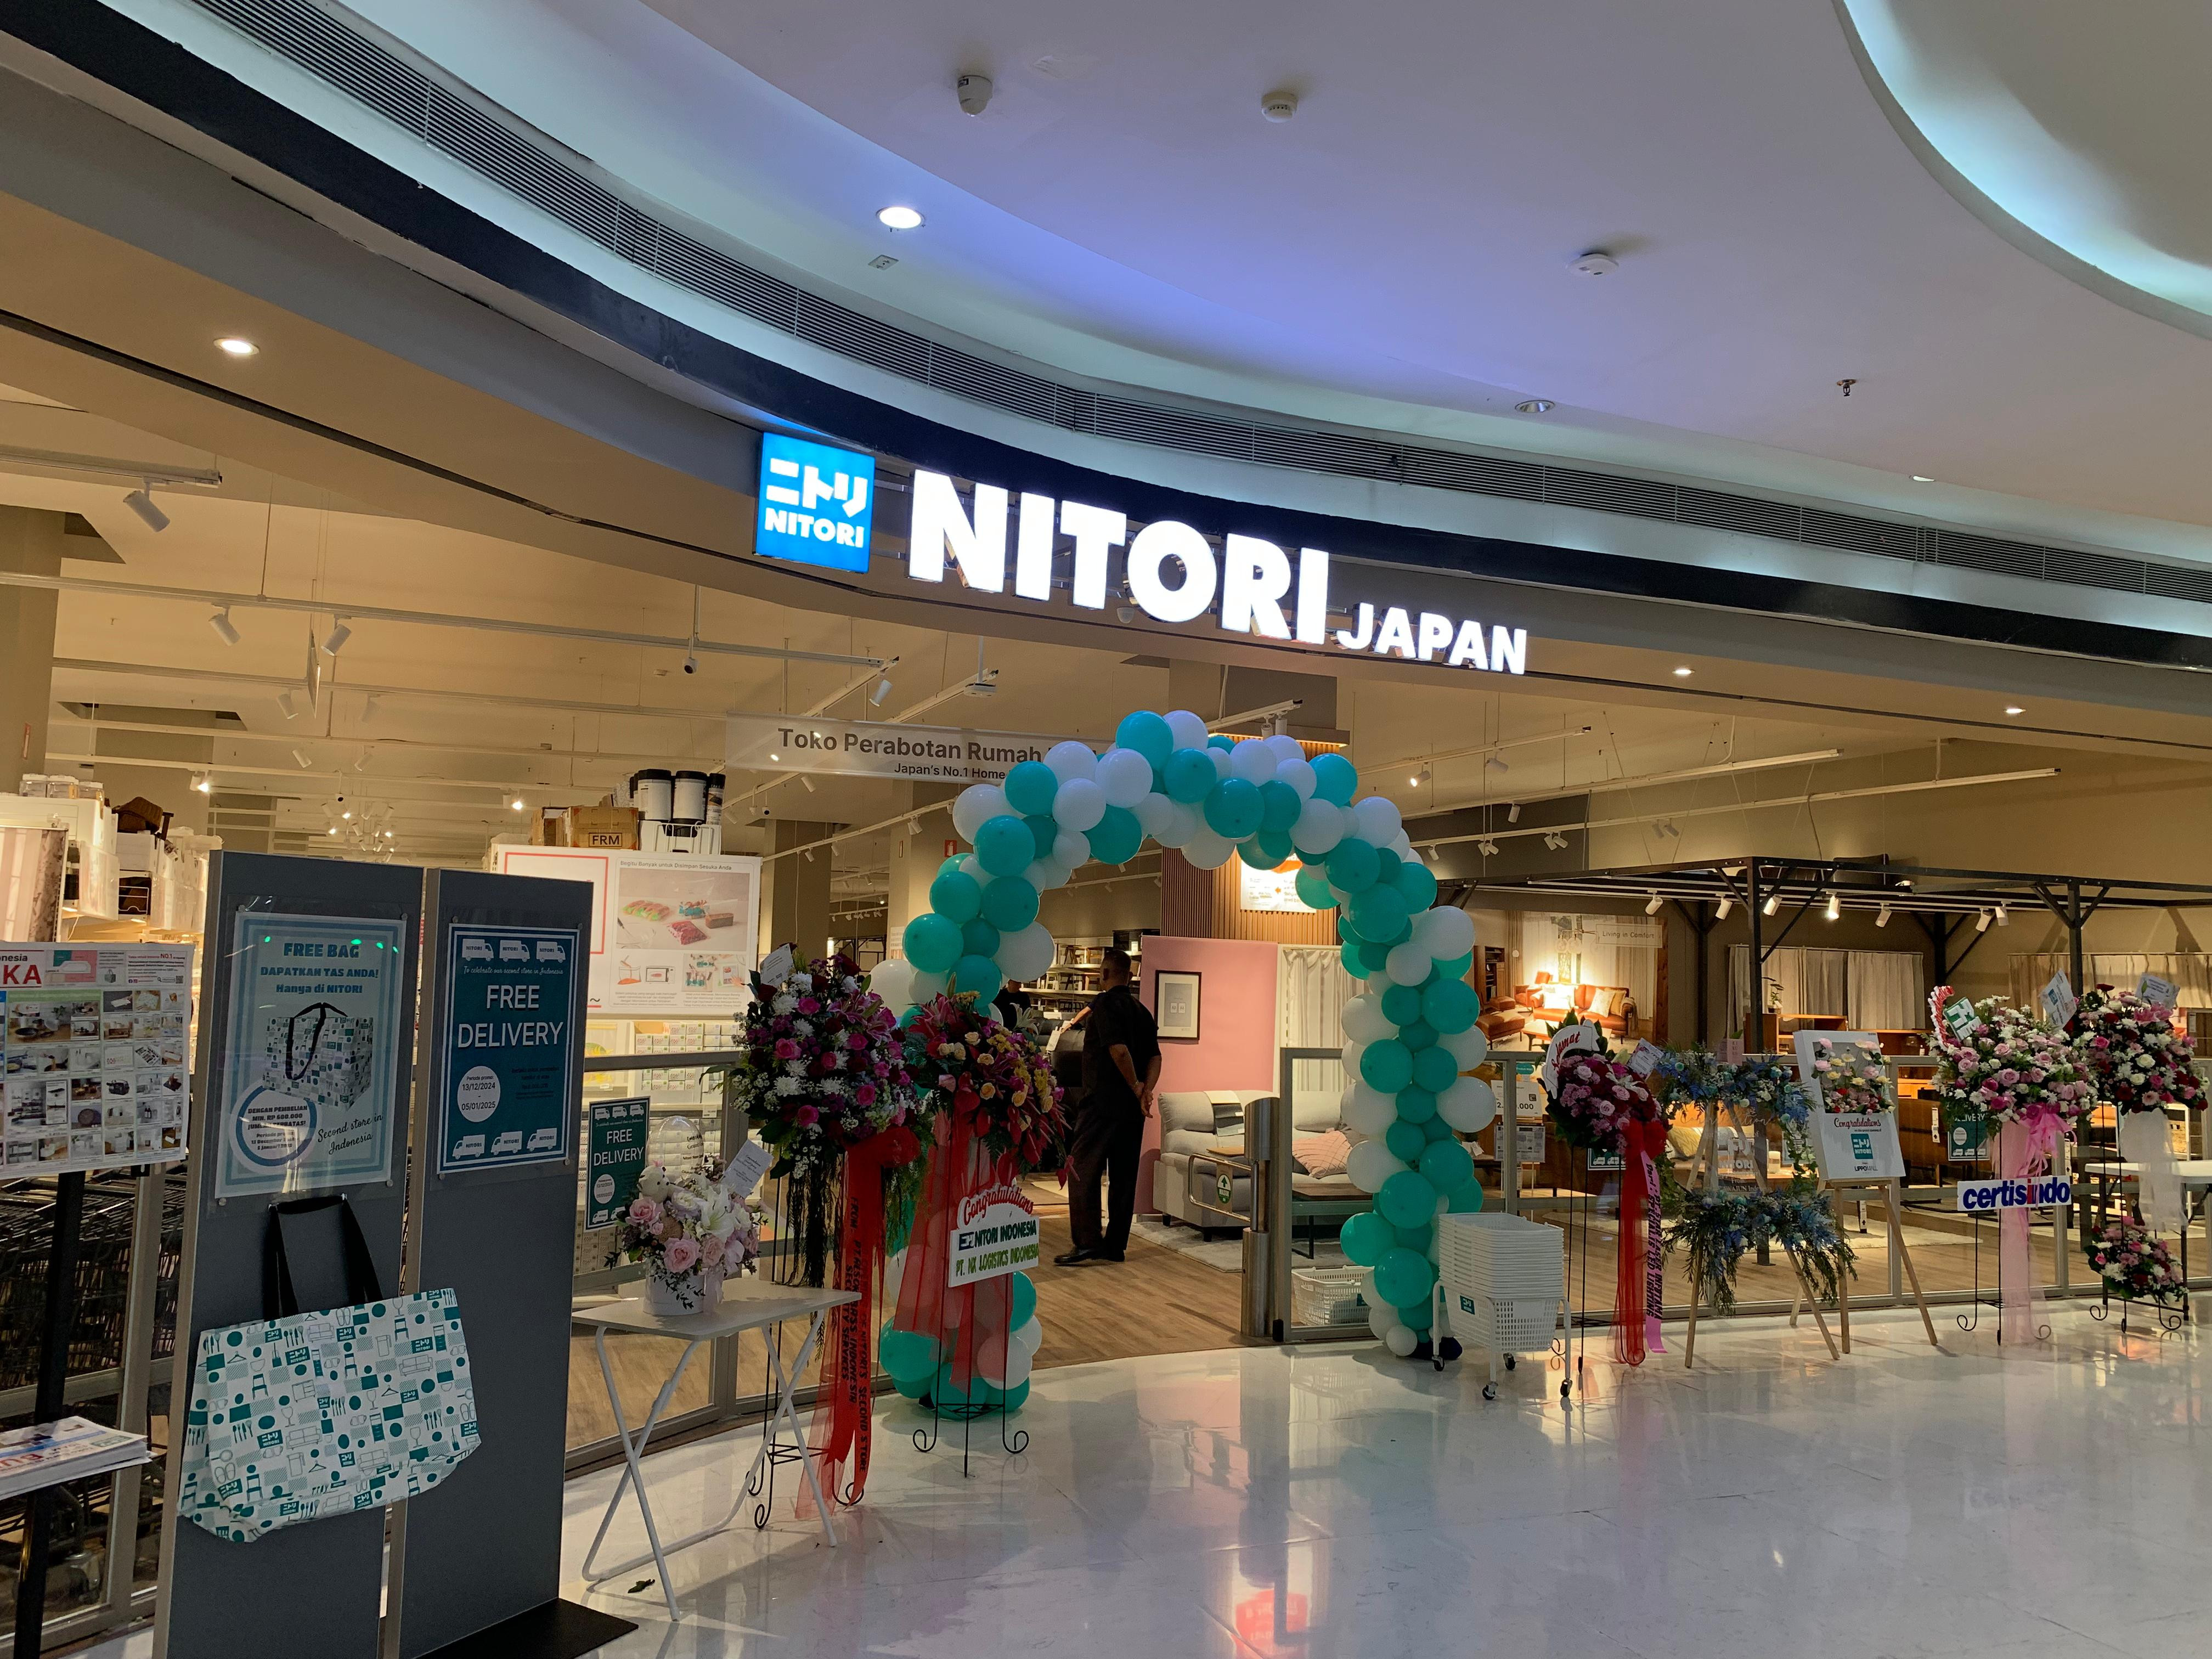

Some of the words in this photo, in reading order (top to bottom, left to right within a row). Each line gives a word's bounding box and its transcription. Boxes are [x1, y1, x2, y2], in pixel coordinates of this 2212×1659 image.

[766, 458, 868, 518] ニトリ
[765, 507, 865, 548] NITORI
[909, 469, 1329, 645] NITORI
[1336, 602, 1527, 675] JAPAN
[777, 728, 837, 750] Toko
[844, 733, 962, 760] Perabotan
[967, 742, 1042, 763] Rumah
[894, 763, 940, 776] Japan's
[943, 766, 968, 777] No.1
[972, 769, 1006, 780] Home
[592, 835, 619, 845] FRM
[283, 943, 324, 957] FREE
[326, 944, 360, 958] BAG
[261, 967, 321, 976] DAPATKAN
[323, 968, 345, 977] TAS
[346, 969, 379, 978] ANDA!
[464, 966, 470, 975] To
[276, 984, 312, 995] Hanya
[314, 984, 325, 993] di
[327, 985, 363, 994] NITORI
[486, 985, 540, 1009] FREE
[458, 1022, 564, 1048] DELIVERY
[462, 1082, 495, 1091] 13/12/2024
[461, 1101, 495, 1110] 05/01/2025
[318, 1122, 348, 1143] Second
[351, 1118, 372, 1131] store
[374, 1113, 384, 1122] in
[1834, 1118, 1881, 1129] Congratulations
[329, 1132, 374, 1155] Indonesia
[607, 1128, 633, 1144] FREE
[594, 1147, 644, 1166] DELIVERY
[1963, 1177, 2070, 1209] certisindo
[964, 1186, 1034, 1226] Congratulations
[1648, 1194, 1656, 1248] SPECIALIS
[974, 1226, 998, 1248] NITORI
[1000, 1219, 1037, 1243] INDONESIA
[956, 1258, 965, 1277] PT.
[968, 1256, 977, 1274] NX
[979, 1249, 1009, 1271] LOGISTICS
[1011, 1243, 1039, 1265] INDONESIA
[1646, 1272, 1655, 1317] LIGHTING
[1654, 1273, 1663, 1319] INFOTAMA
[289, 1348, 306, 1358] ニトリ
[415, 1339, 430, 1347] ニトリ
[849, 1338, 858, 1404] INDONESIA
[858, 1386, 868, 1432] SECOND
[262, 1432, 279, 1442] ニトリ
[859, 1435, 868, 1472] STORE
[220, 1481, 237, 1494] ニトリ
